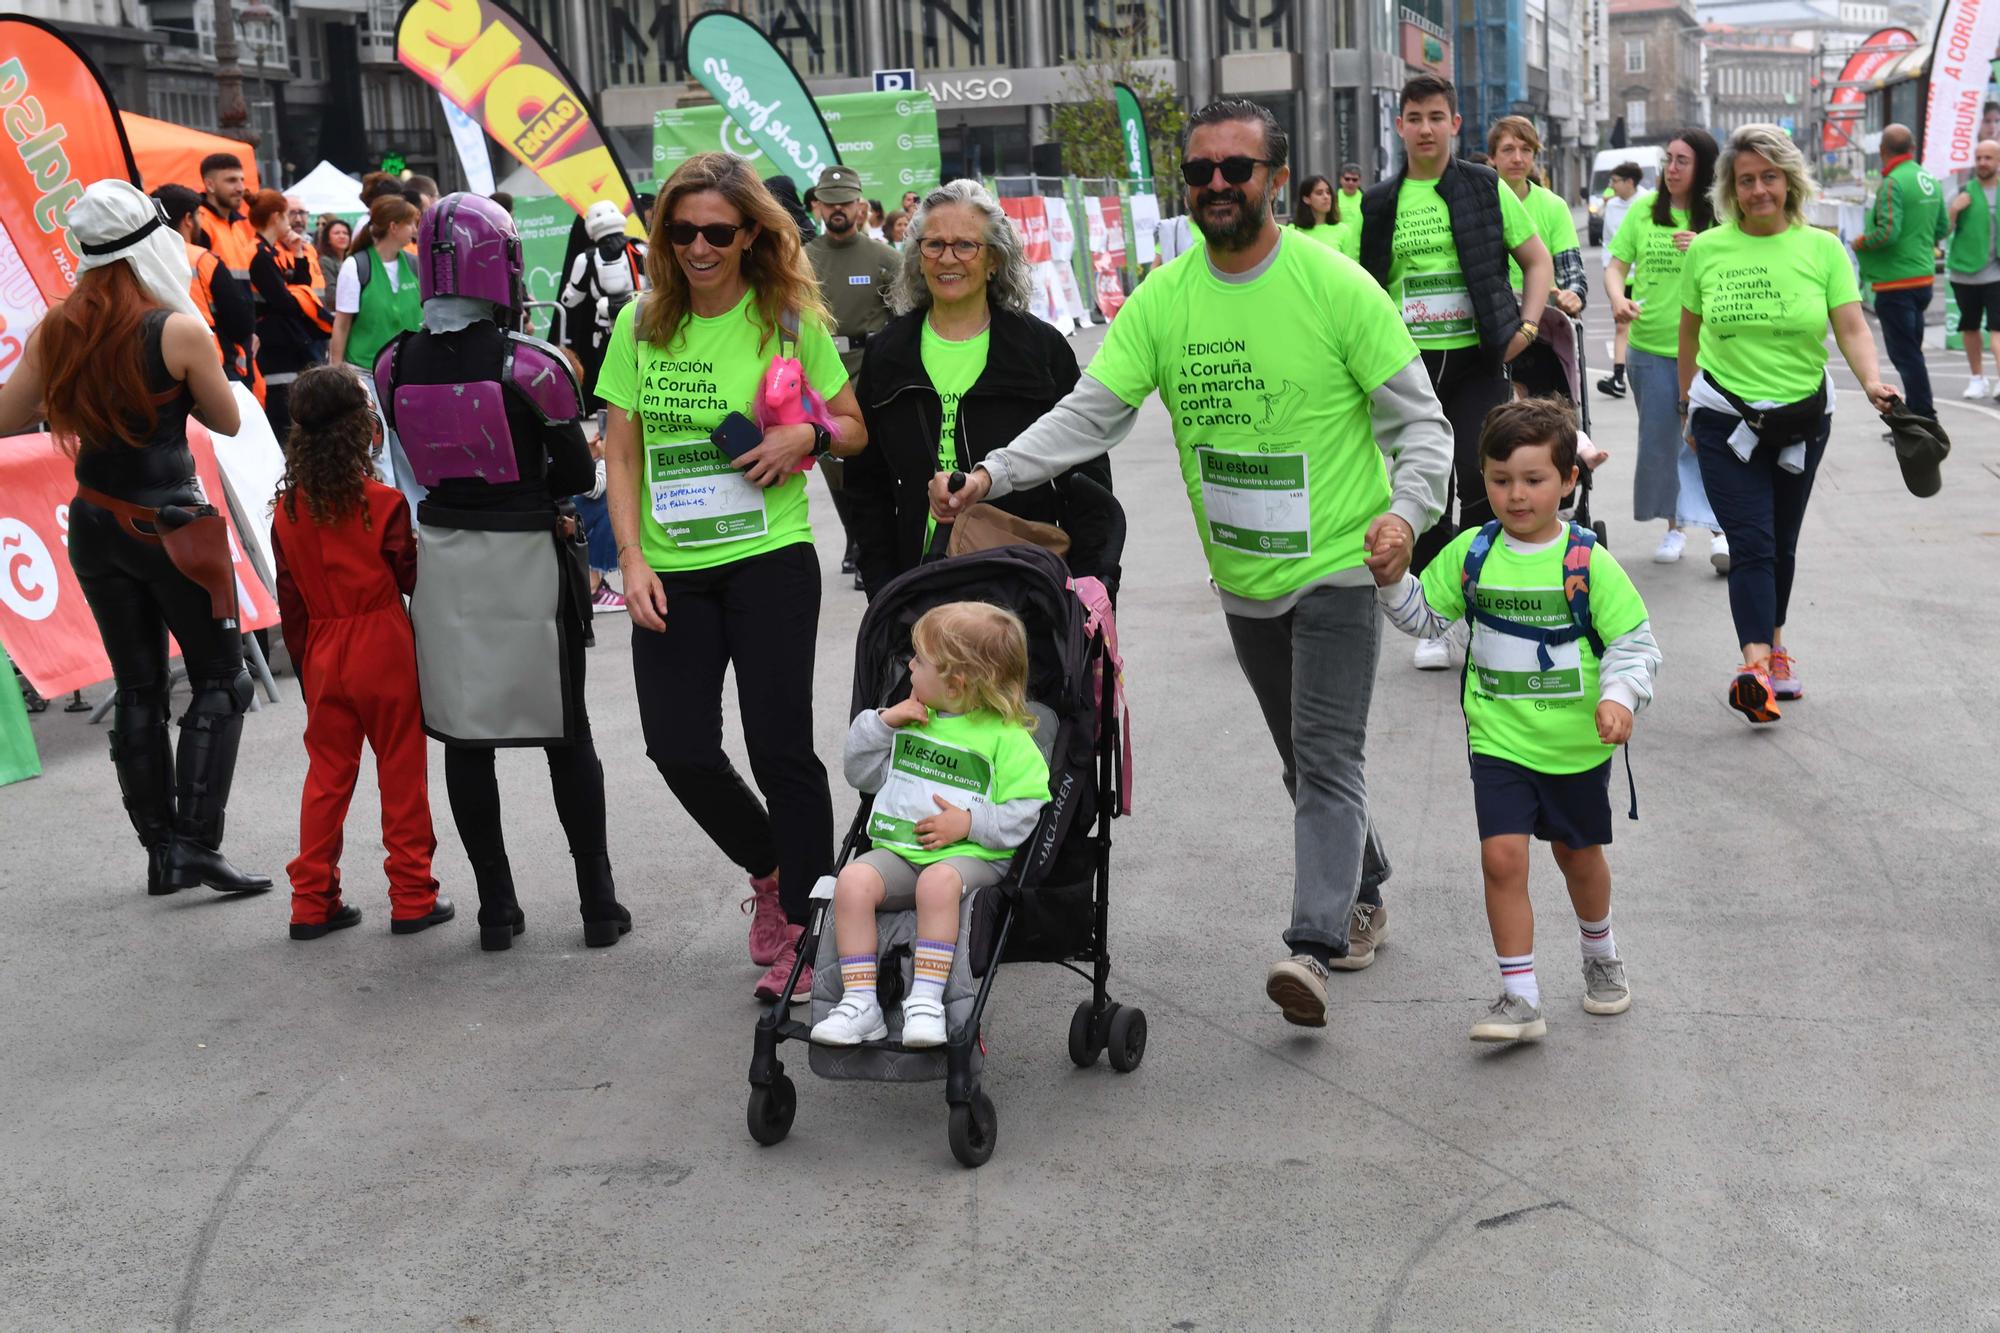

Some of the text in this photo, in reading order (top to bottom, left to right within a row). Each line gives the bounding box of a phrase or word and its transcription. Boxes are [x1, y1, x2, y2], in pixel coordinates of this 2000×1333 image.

[924, 77, 1012, 102] ANGO
[1950, 90, 1979, 162] CORUÑA
[837, 141, 873, 152] ancro
[1726, 279, 1771, 291] Coruña
[1713, 289, 1781, 302] en marcha
[1711, 302, 1753, 313] contra
[1711, 312, 1769, 324] o cancro
[1188, 338, 1246, 356] EDICIÓN
[648, 359, 713, 374] X EDICIÓN
[1191, 359, 1252, 377] Coruña
[645, 376, 717, 393] A Coruña
[1178, 376, 1265, 394] en marcha
[643, 394, 728, 410] en marcha
[1180, 395, 1232, 411] contra
[643, 410, 693, 424] contra
[1182, 413, 1252, 426] o cancro
[657, 449, 721, 466] Eu estou
[1207, 455, 1269, 475] Eu estou
[666, 467, 691, 477] marcha
[691, 465, 714, 473] contra
[1216, 474, 1239, 484] marcha
[1240, 478, 1263, 486] contra
[1476, 593, 1542, 611] Eu estou
[1508, 613, 1534, 623] contra
[1542, 613, 1567, 622] cancro
[915, 747, 959, 770] estou
[920, 766, 946, 779] contra
[1039, 772, 1074, 866] MACLAREN
